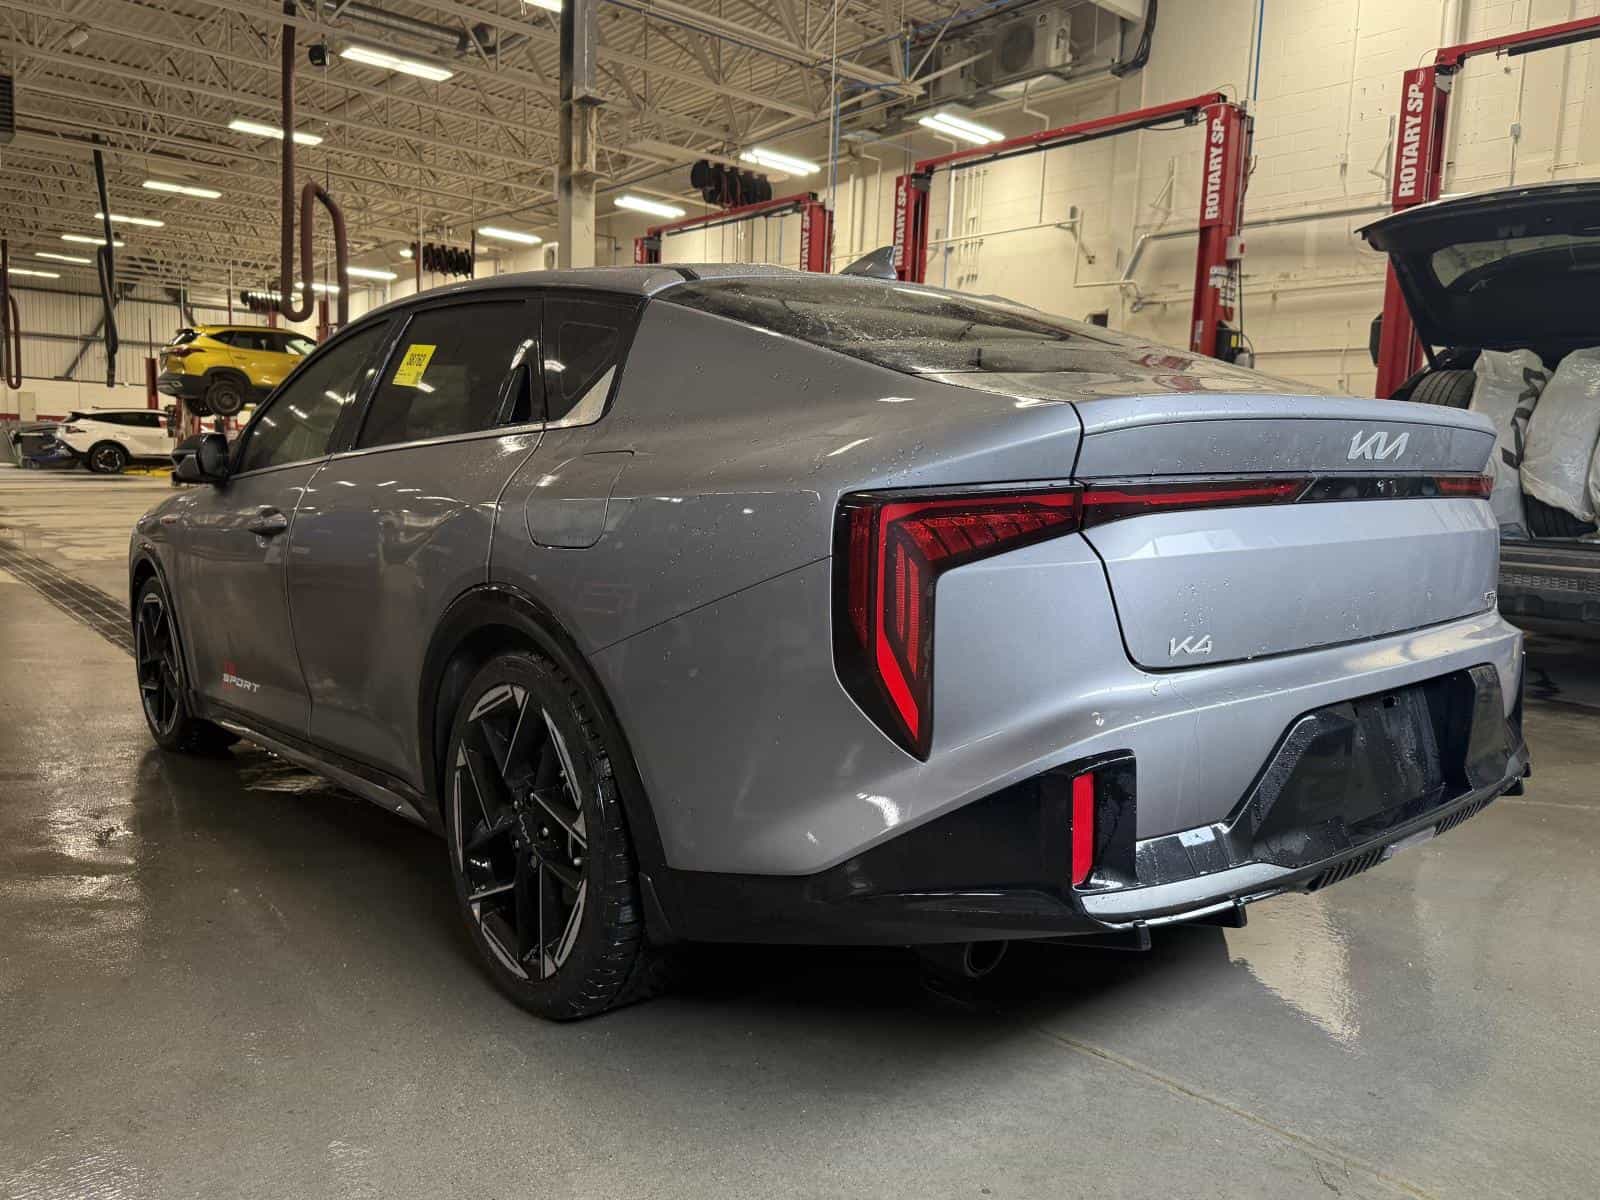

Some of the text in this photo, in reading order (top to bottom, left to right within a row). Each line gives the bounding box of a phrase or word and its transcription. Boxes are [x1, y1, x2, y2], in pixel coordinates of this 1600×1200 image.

[1398, 83, 1425, 197] ROTARY SP
[1205, 119, 1225, 220] ROTARY SP
[1347, 429, 1410, 461] KIA
[1169, 635, 1213, 656] K4
[223, 673, 261, 692] SPORT
